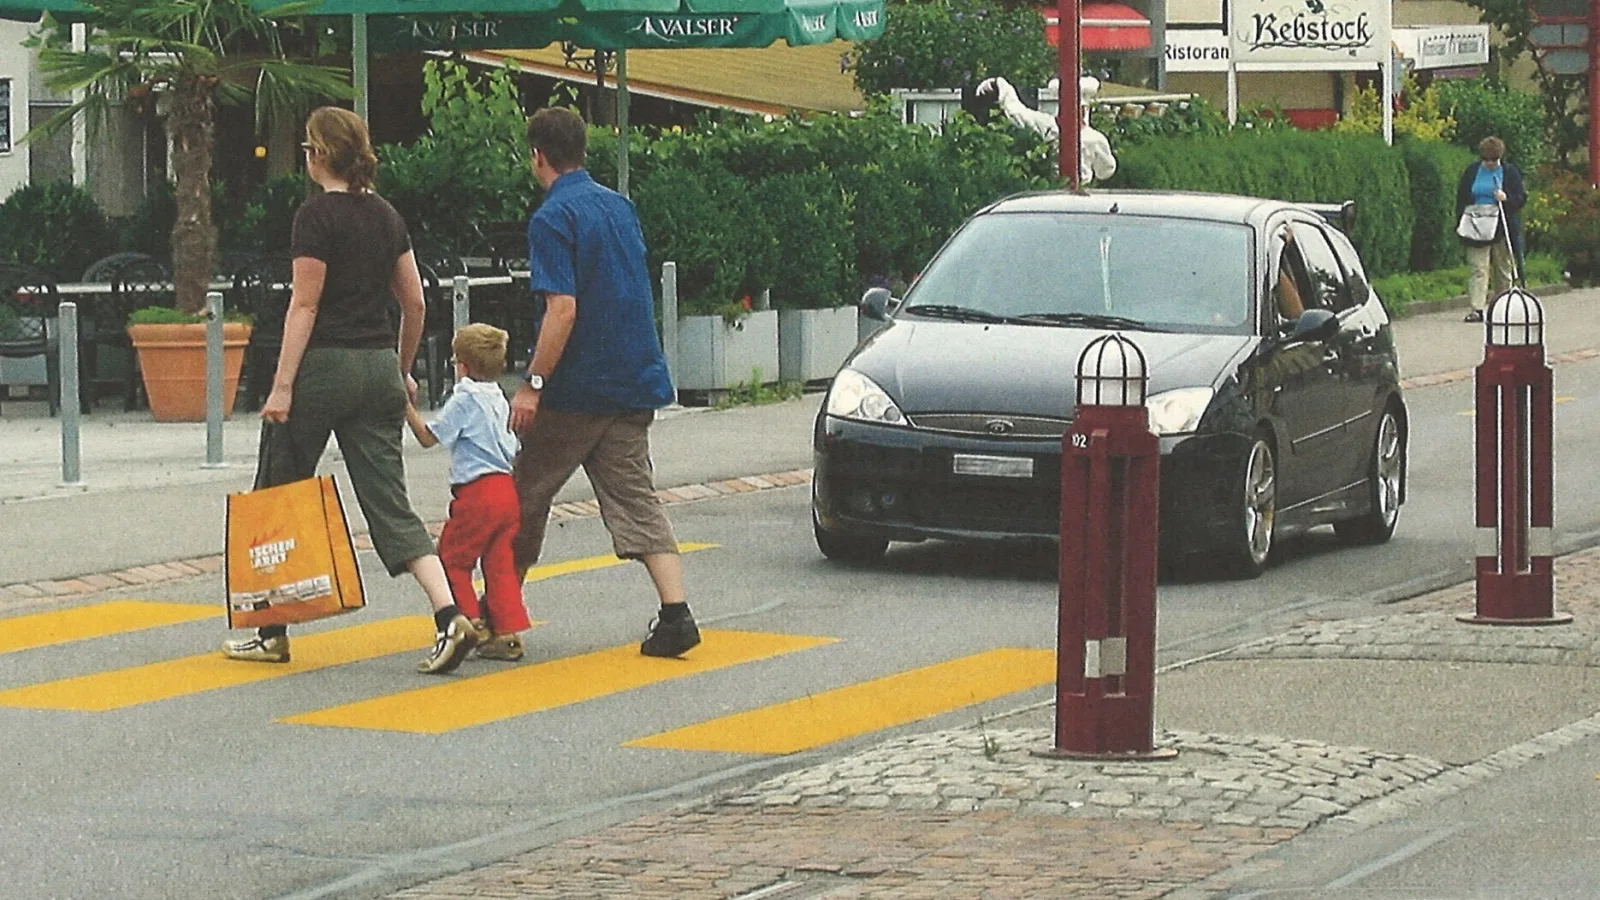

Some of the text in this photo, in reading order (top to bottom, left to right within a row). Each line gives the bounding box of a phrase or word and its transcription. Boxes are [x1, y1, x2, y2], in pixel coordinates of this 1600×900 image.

[428, 20, 499, 38] VSER
[659, 18, 735, 36] VALSER
[1253, 12, 1370, 43] Rebstock
